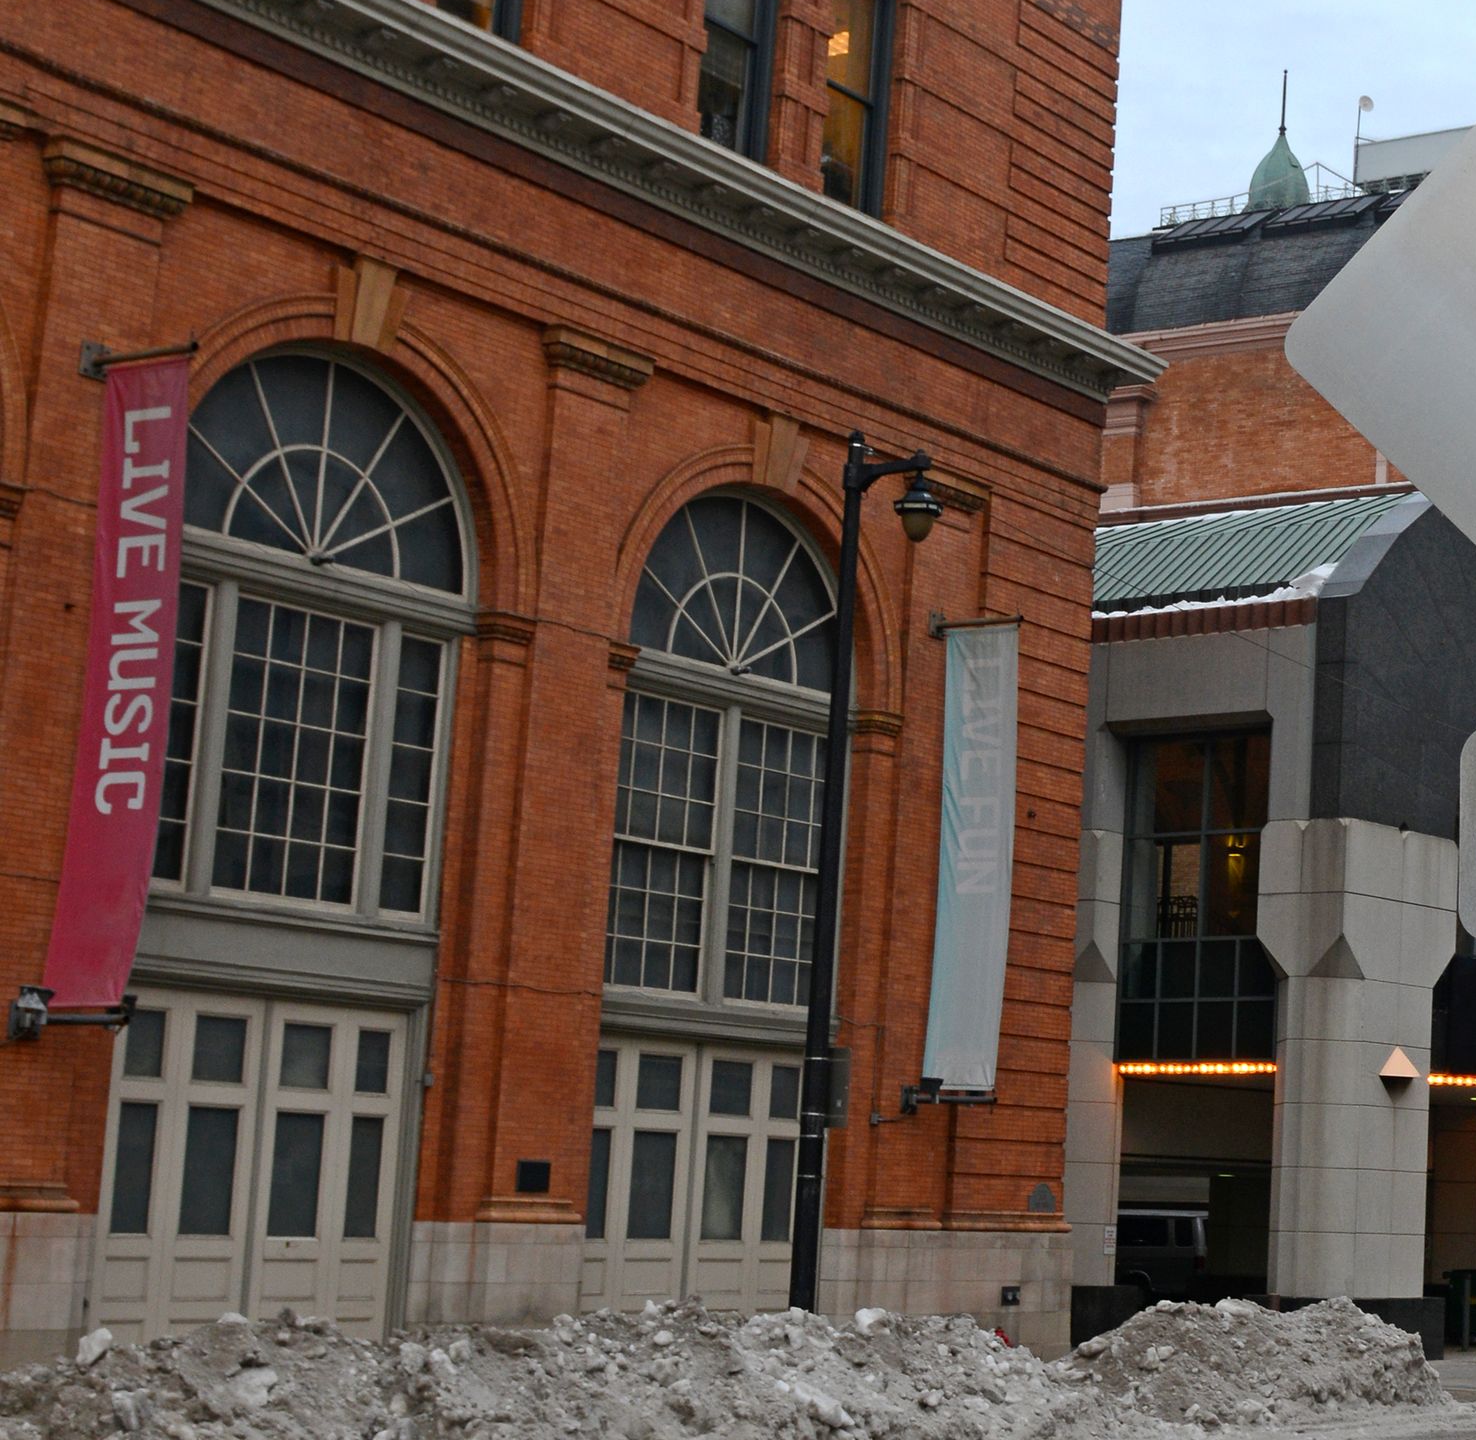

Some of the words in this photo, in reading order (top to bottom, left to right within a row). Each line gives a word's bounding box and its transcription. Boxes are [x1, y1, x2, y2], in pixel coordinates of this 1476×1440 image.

[116, 406, 172, 579] LIVE
[93, 598, 163, 816] MUSIC
[959, 655, 1001, 781] LIVE
[955, 796, 1001, 895] FUN
